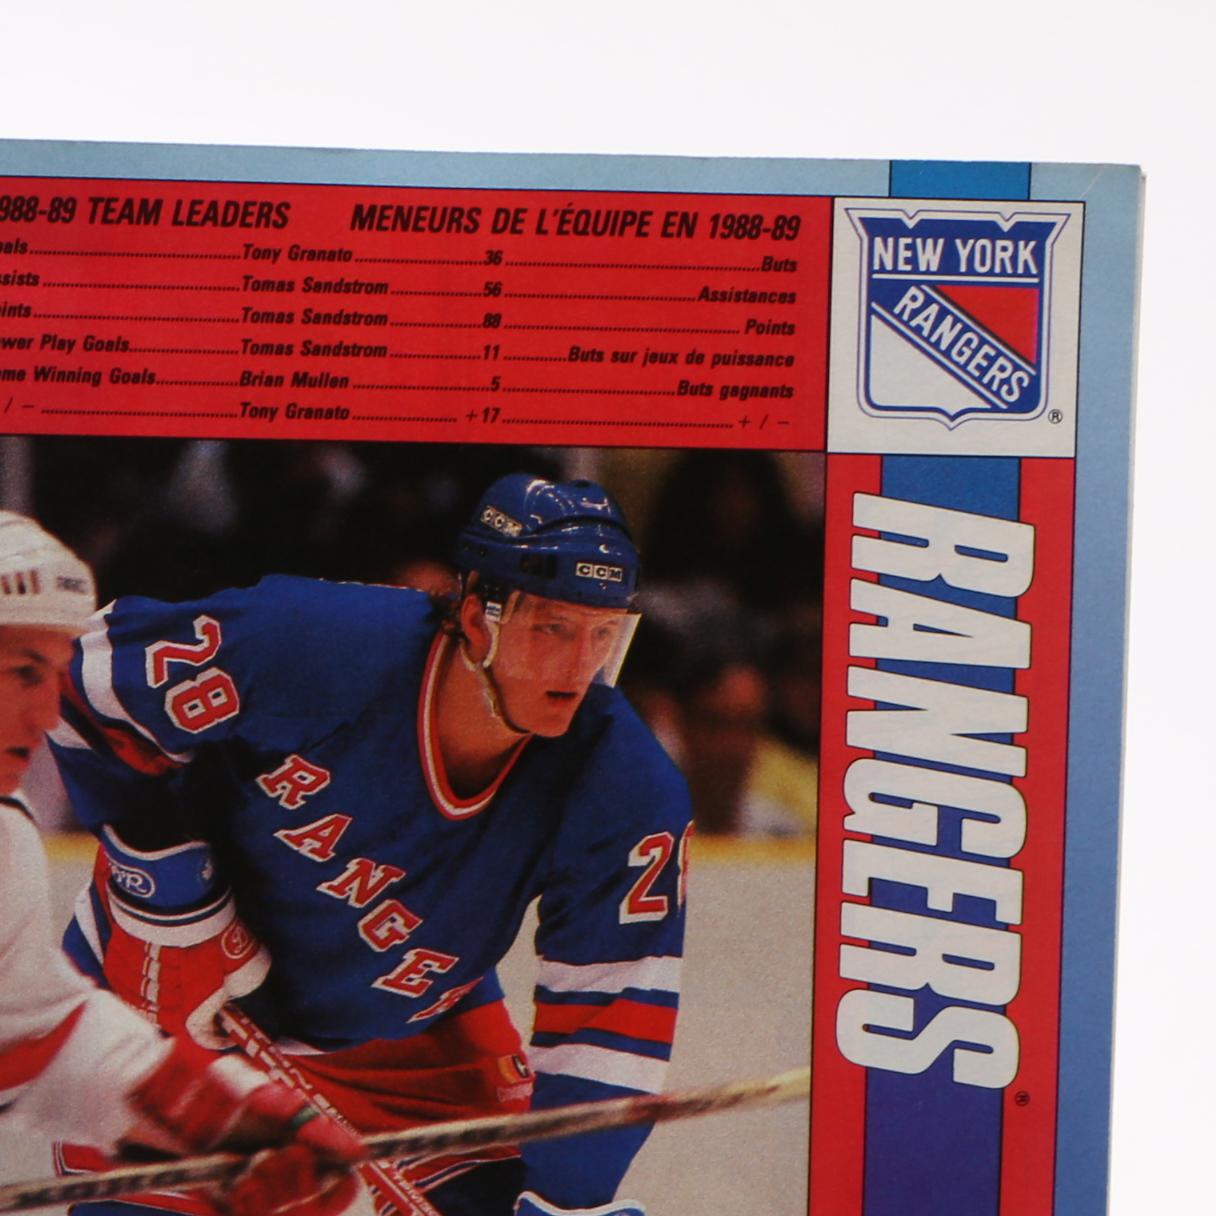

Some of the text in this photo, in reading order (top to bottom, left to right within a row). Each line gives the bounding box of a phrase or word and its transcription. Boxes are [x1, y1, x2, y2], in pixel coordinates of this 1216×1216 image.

[87, 198, 163, 225] TEAM
[172, 200, 291, 228] LEADERS
[350, 202, 800, 241] MENEURS DE L'ÉQUIPE EN 1988-89
[243, 244, 281, 263] Tony
[288, 245, 352, 262] Granato
[484, 250, 503, 266] 36
[761, 257, 798, 273] Buts
[873, 236, 1037, 274] NEW YORK
[242, 275, 294, 293] Tomas
[301, 277, 389, 295] Sandstrom
[484, 282, 502, 297] 56
[698, 287, 796, 304] Assistances
[241, 307, 294, 324] Tomas
[301, 309, 388, 326] Sandstrom
[482, 314, 501, 329] 88
[745, 320, 795, 336] Points
[40, 334, 75, 354] Play
[83, 336, 129, 352] Goals
[241, 339, 293, 356] Tomas
[301, 341, 387, 358] Sandstrom
[483, 345, 499, 360] 11
[569, 347, 604, 363] Buts
[610, 350, 636, 364] sur
[643, 349, 678, 367] jeux
[685, 350, 704, 366] de
[710, 351, 794, 369] puissance
[894, 285, 1030, 403] RANGERS
[33, 366, 102, 386] Winning
[110, 367, 155, 384] Goals
[240, 370, 283, 387] Brian
[291, 372, 349, 389] Mullen
[490, 377, 500, 391] 5
[677, 381, 713, 396] Buts
[720, 383, 794, 400] gagnants
[240, 402, 500, 423] Tony Granato +17
[576, 562, 623, 582] CCM
[144, 614, 239, 733] 28
[836, 492, 1036, 1089] RANGERS
[619, 820, 697, 925] 2
